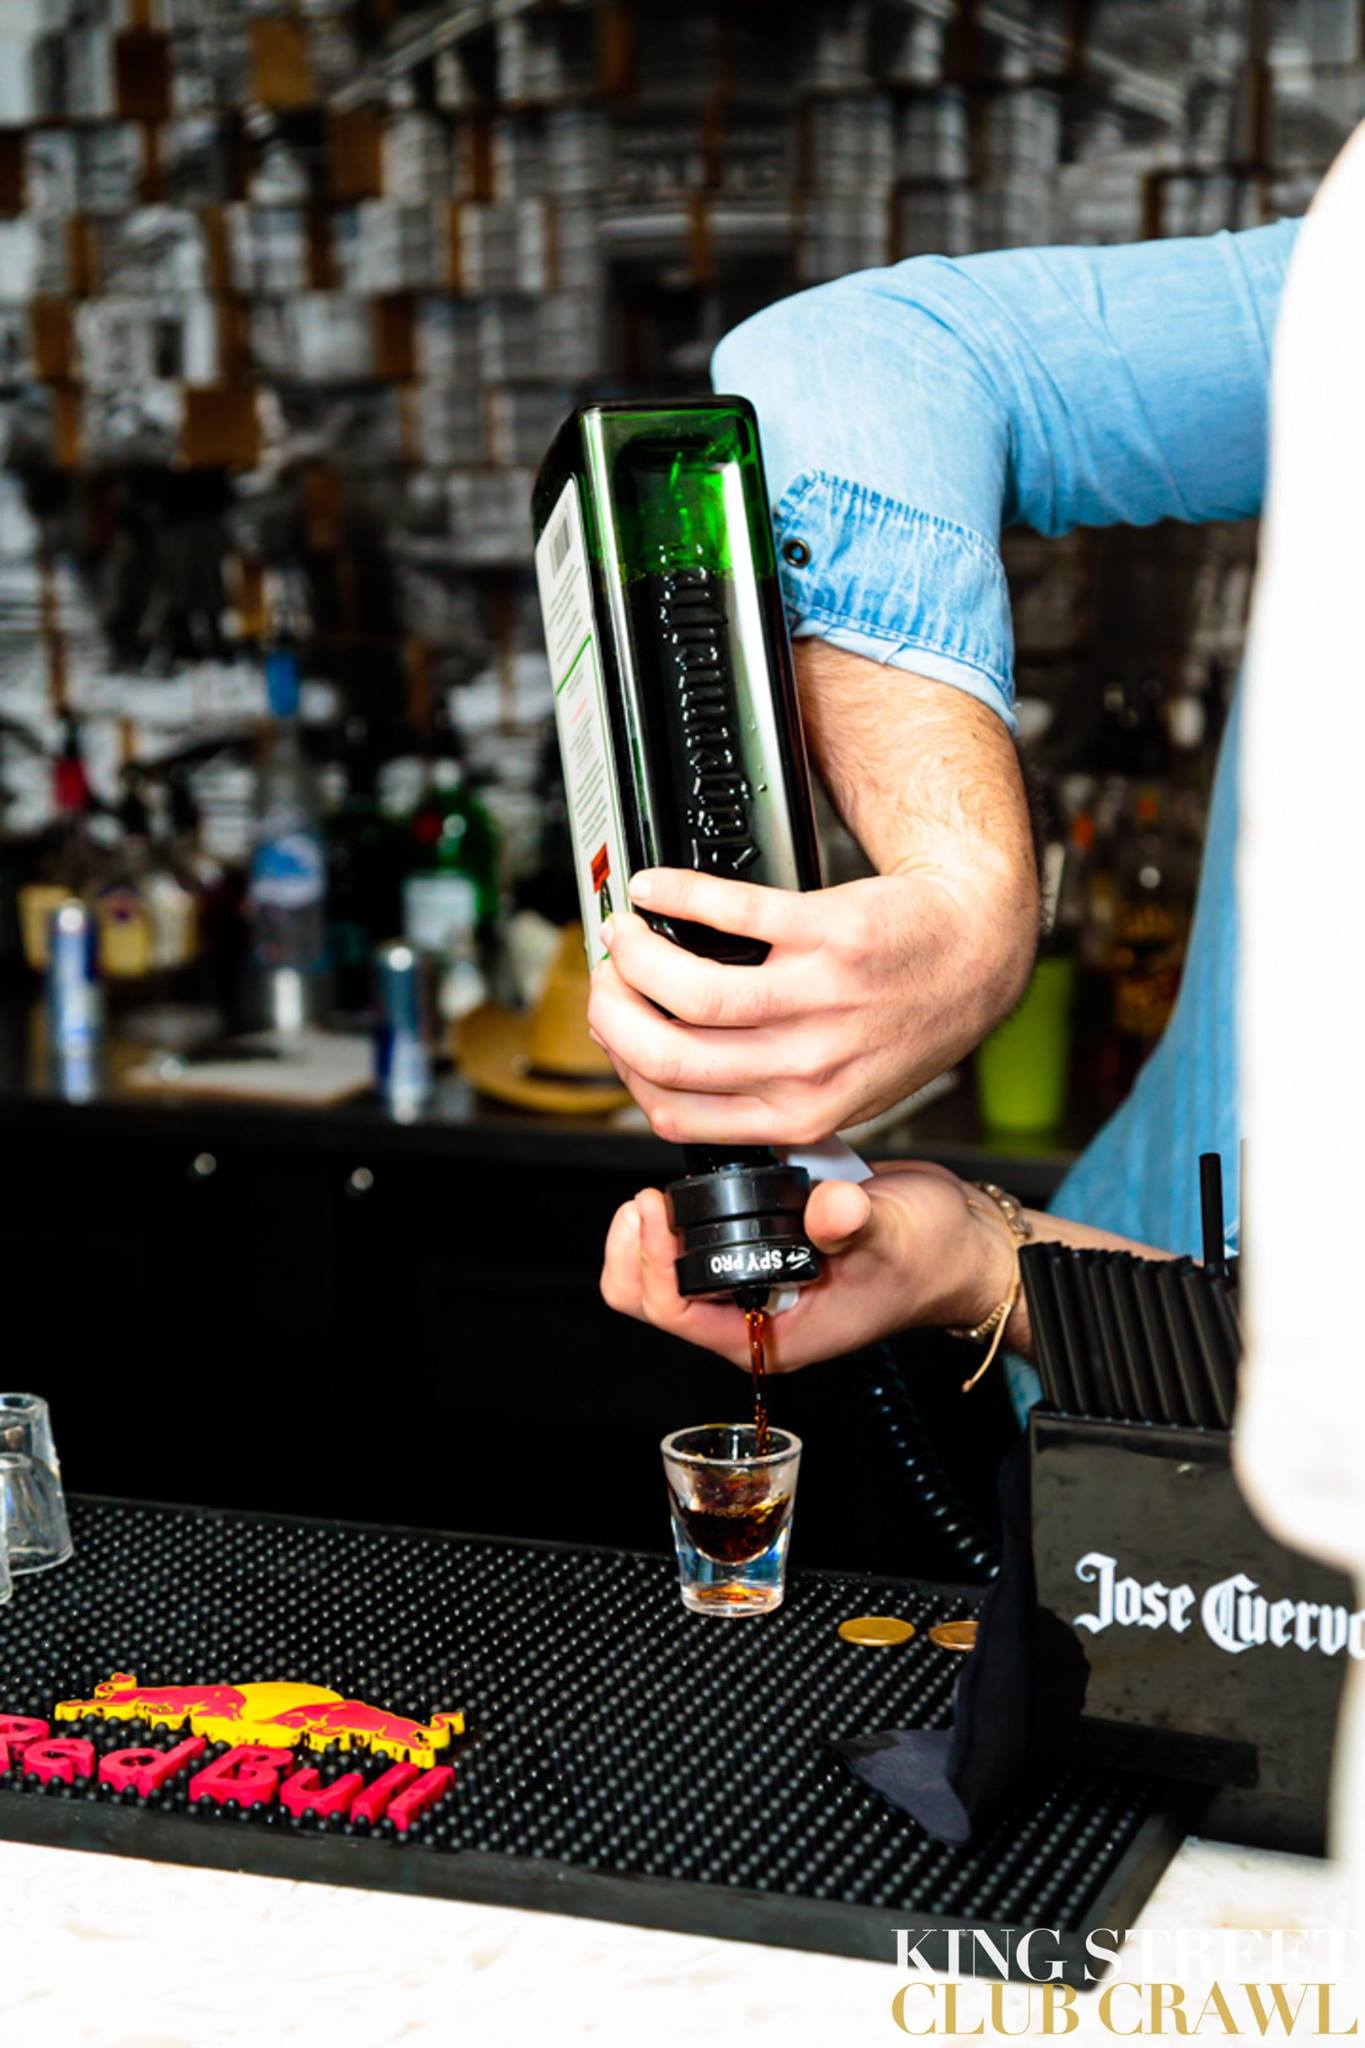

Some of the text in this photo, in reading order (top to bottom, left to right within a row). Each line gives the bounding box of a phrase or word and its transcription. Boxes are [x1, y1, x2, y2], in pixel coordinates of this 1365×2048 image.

[710, 1250, 784, 1274] SPY PRO
[1072, 1551, 1196, 1634] Jose
[189, 1744, 456, 1831] Bull
